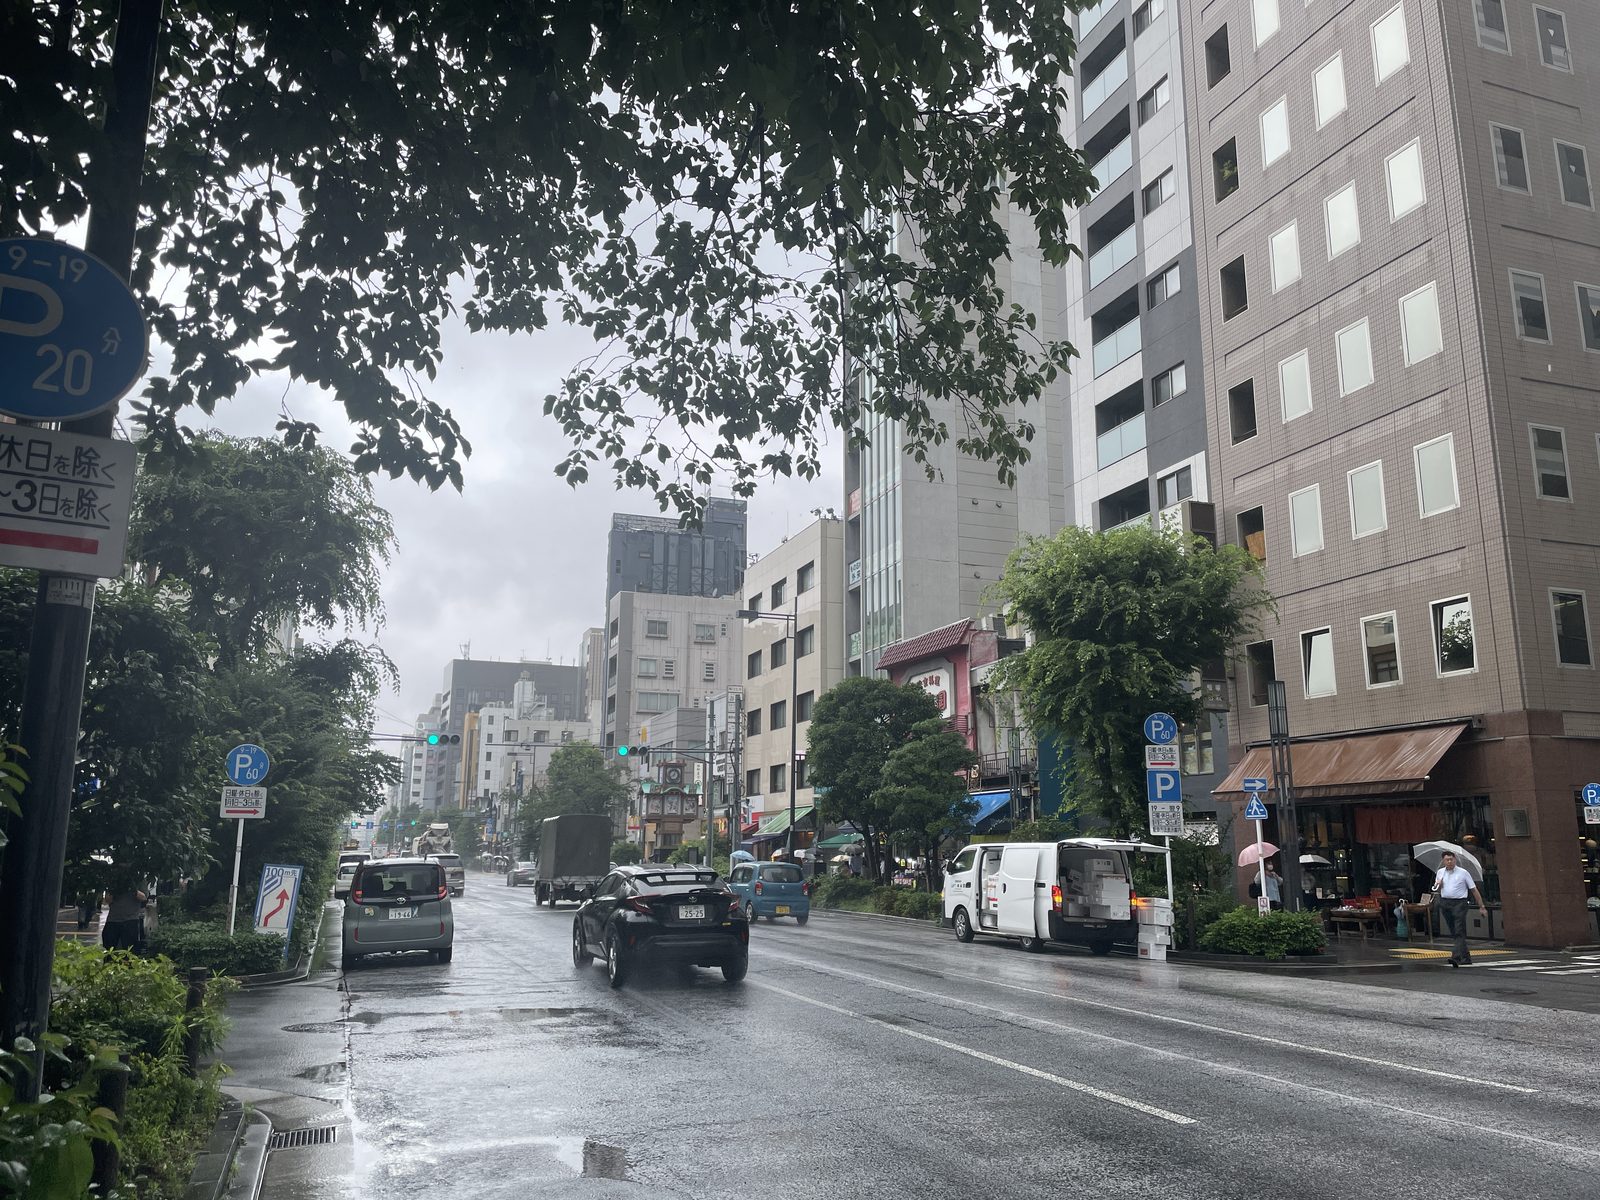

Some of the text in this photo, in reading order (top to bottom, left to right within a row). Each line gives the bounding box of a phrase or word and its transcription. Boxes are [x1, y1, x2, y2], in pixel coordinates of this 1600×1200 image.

[8, 245, 88, 283] 9-19
[101, 327, 122, 356] 分
[32, 343, 94, 396] 20
[0, 434, 117, 482] 休日を除く
[921, 675, 940, 688] 京料理
[1152, 720, 1164, 739] P
[1160, 729, 1171, 740] 60
[235, 754, 252, 779] P
[246, 768, 259, 780] 60
[1156, 773, 1175, 798] P
[1587, 789, 1597, 803] P
[684, 909, 704, 918] 25-25
